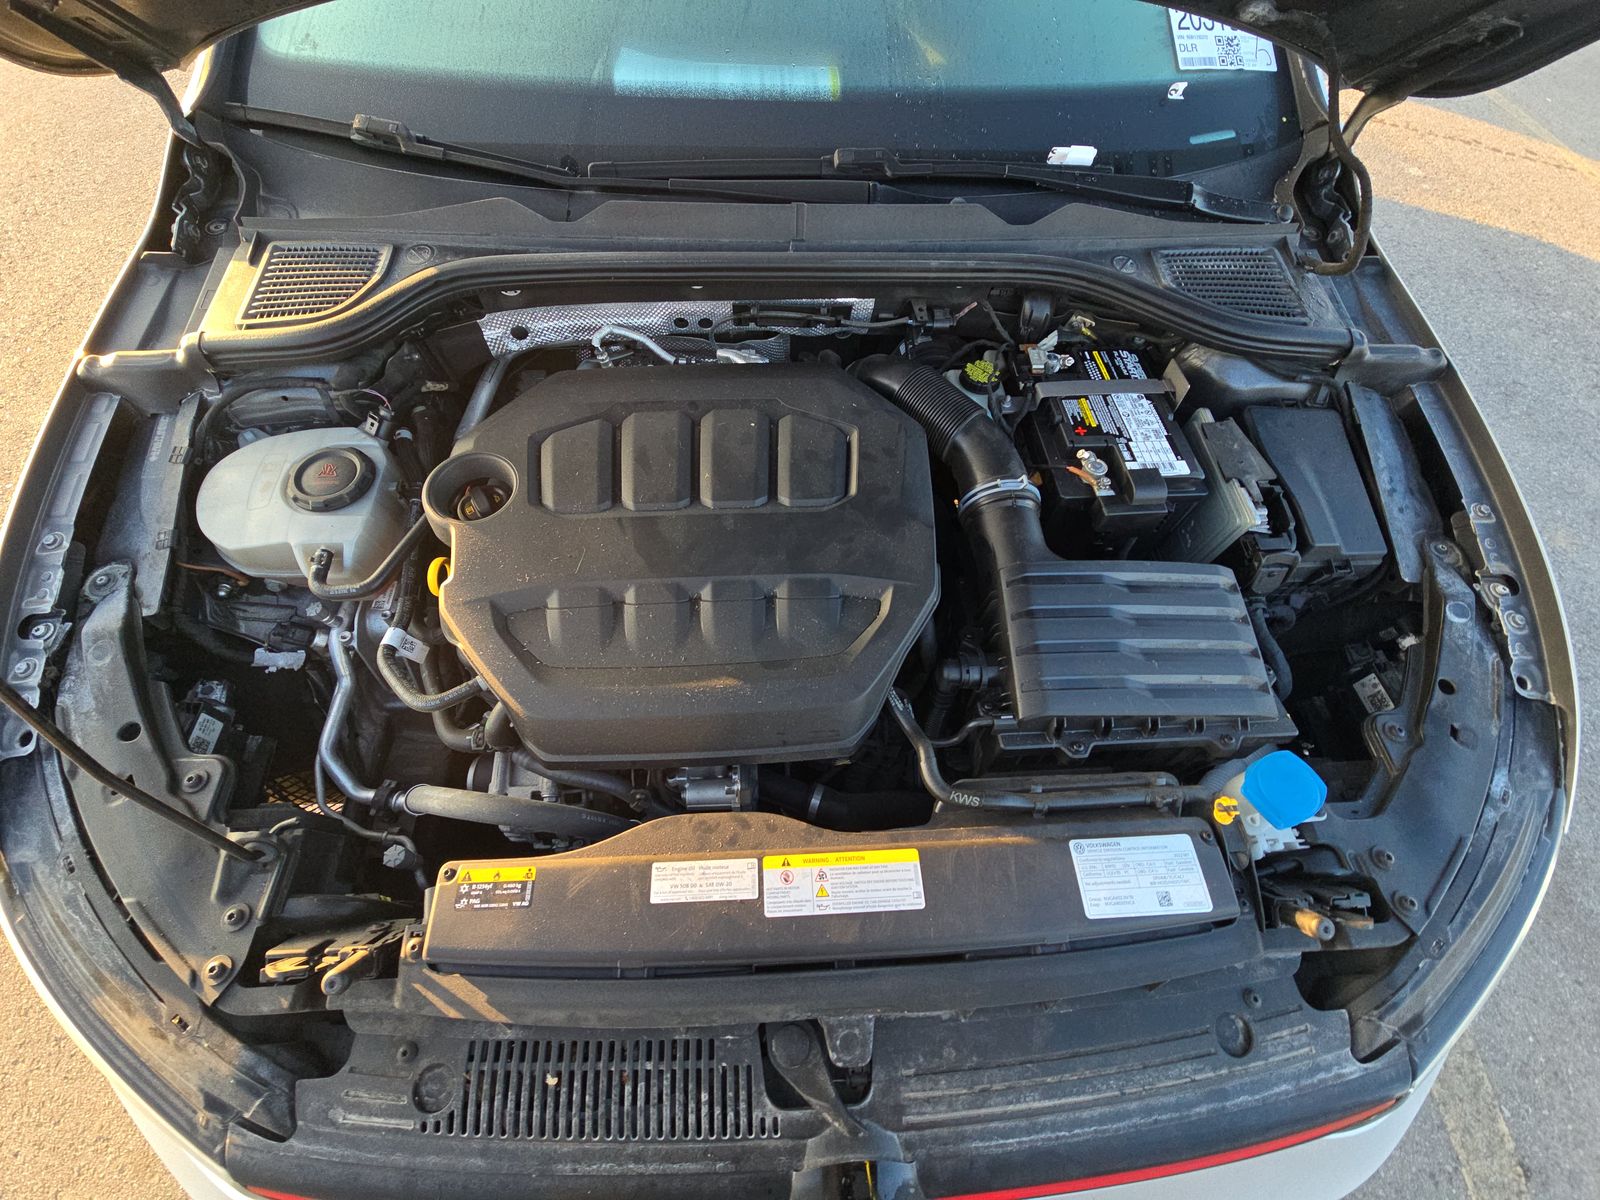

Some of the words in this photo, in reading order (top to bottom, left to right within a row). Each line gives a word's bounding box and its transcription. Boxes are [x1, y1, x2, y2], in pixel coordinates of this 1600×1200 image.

[1179, 43, 1198, 53] DLR
[1119, 350, 1141, 380] START
[1130, 353, 1147, 380] SUPER
[949, 790, 981, 807] KWS
[835, 855, 866, 863] ATTENTION
